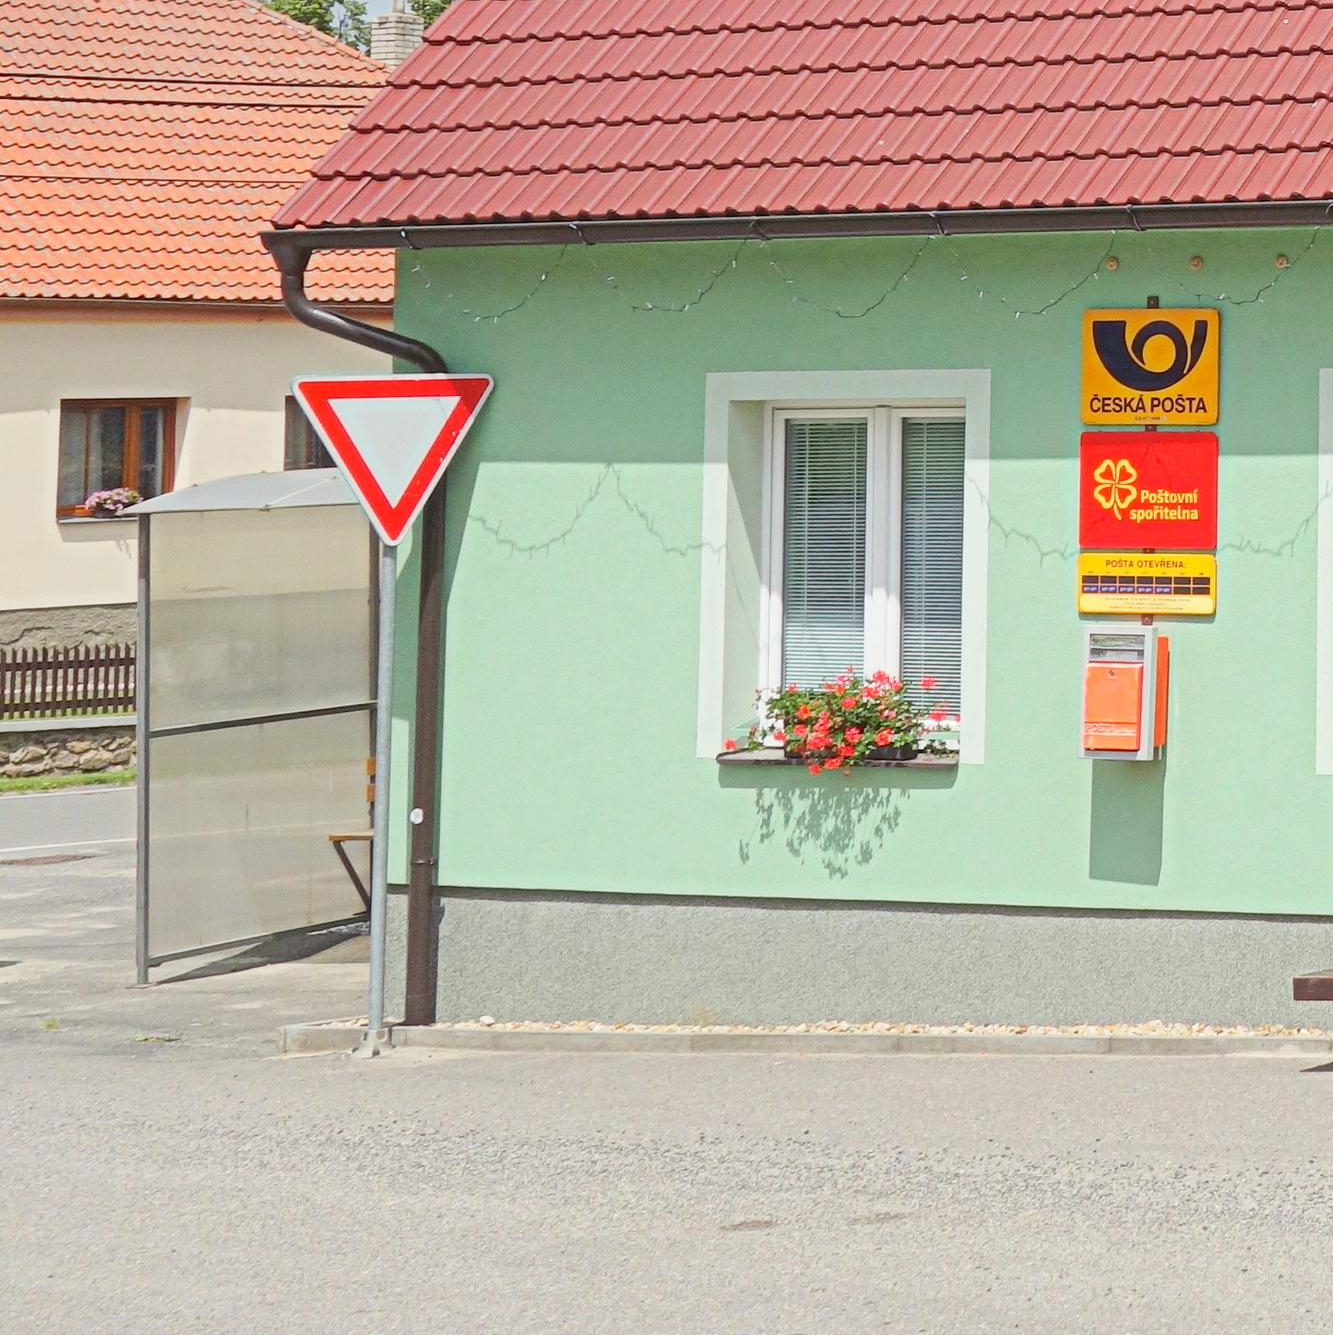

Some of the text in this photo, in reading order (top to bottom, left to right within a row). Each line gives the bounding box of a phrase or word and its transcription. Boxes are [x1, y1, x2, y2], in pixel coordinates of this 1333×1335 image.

[1089, 393, 1208, 414] ČESKÁ POŠTA
[1140, 488, 1199, 504] Poštovní
[1129, 504, 1199, 524] spořitelna
[1105, 558, 1134, 568] POŠTA
